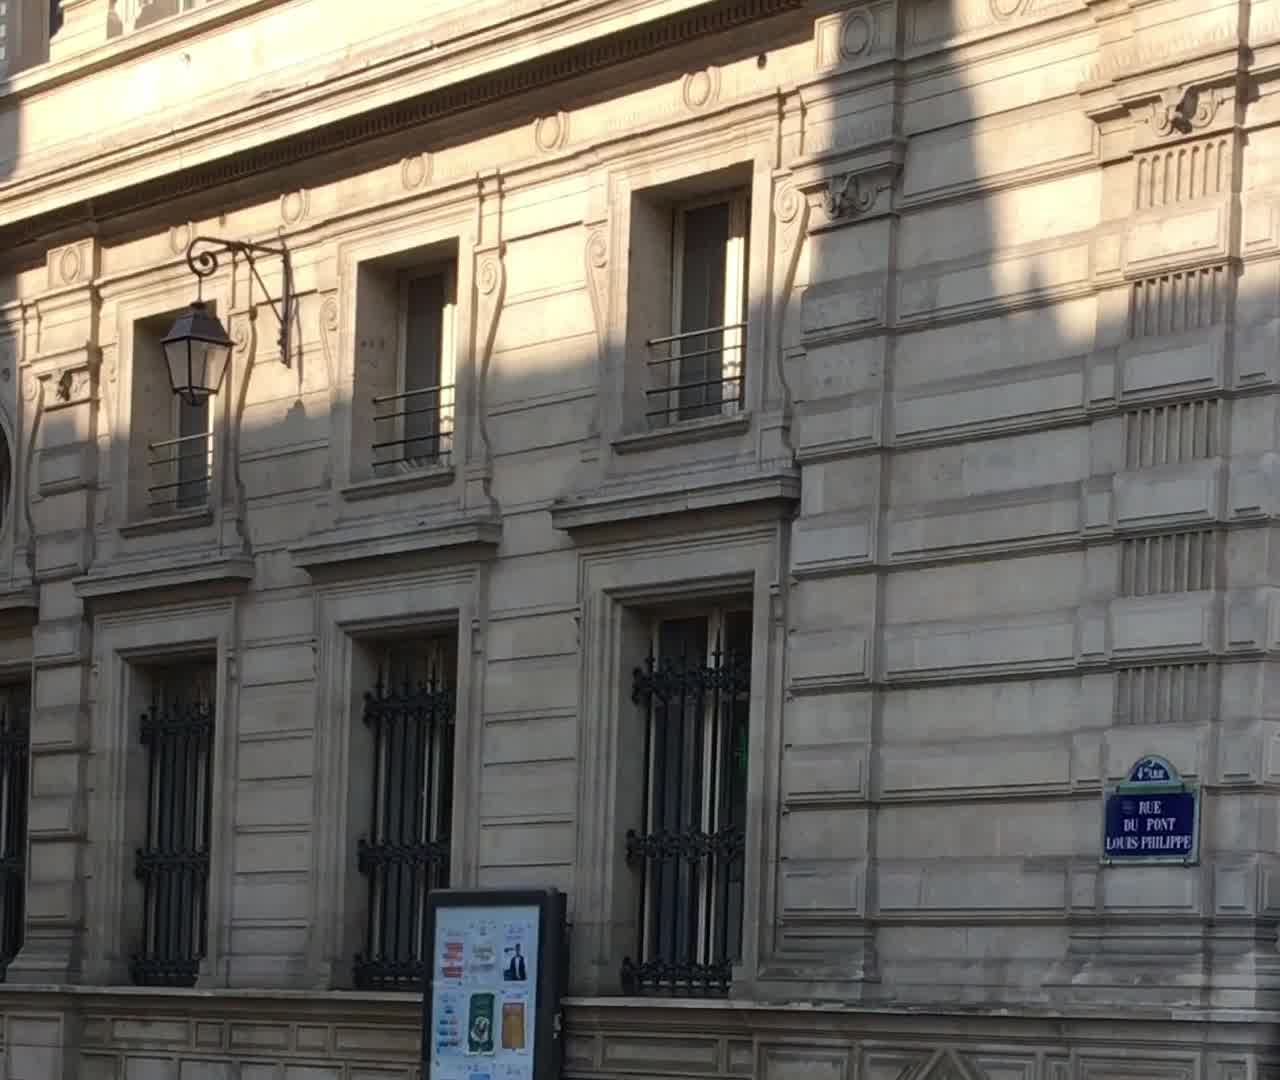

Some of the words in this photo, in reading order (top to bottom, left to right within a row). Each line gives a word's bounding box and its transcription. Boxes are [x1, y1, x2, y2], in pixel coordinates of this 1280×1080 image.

[1138, 800, 1162, 815] RUE
[1123, 819, 1139, 832] DU
[1146, 817, 1176, 832] PONT
[1106, 834, 1192, 850] LOUIS-PHILIPPE
